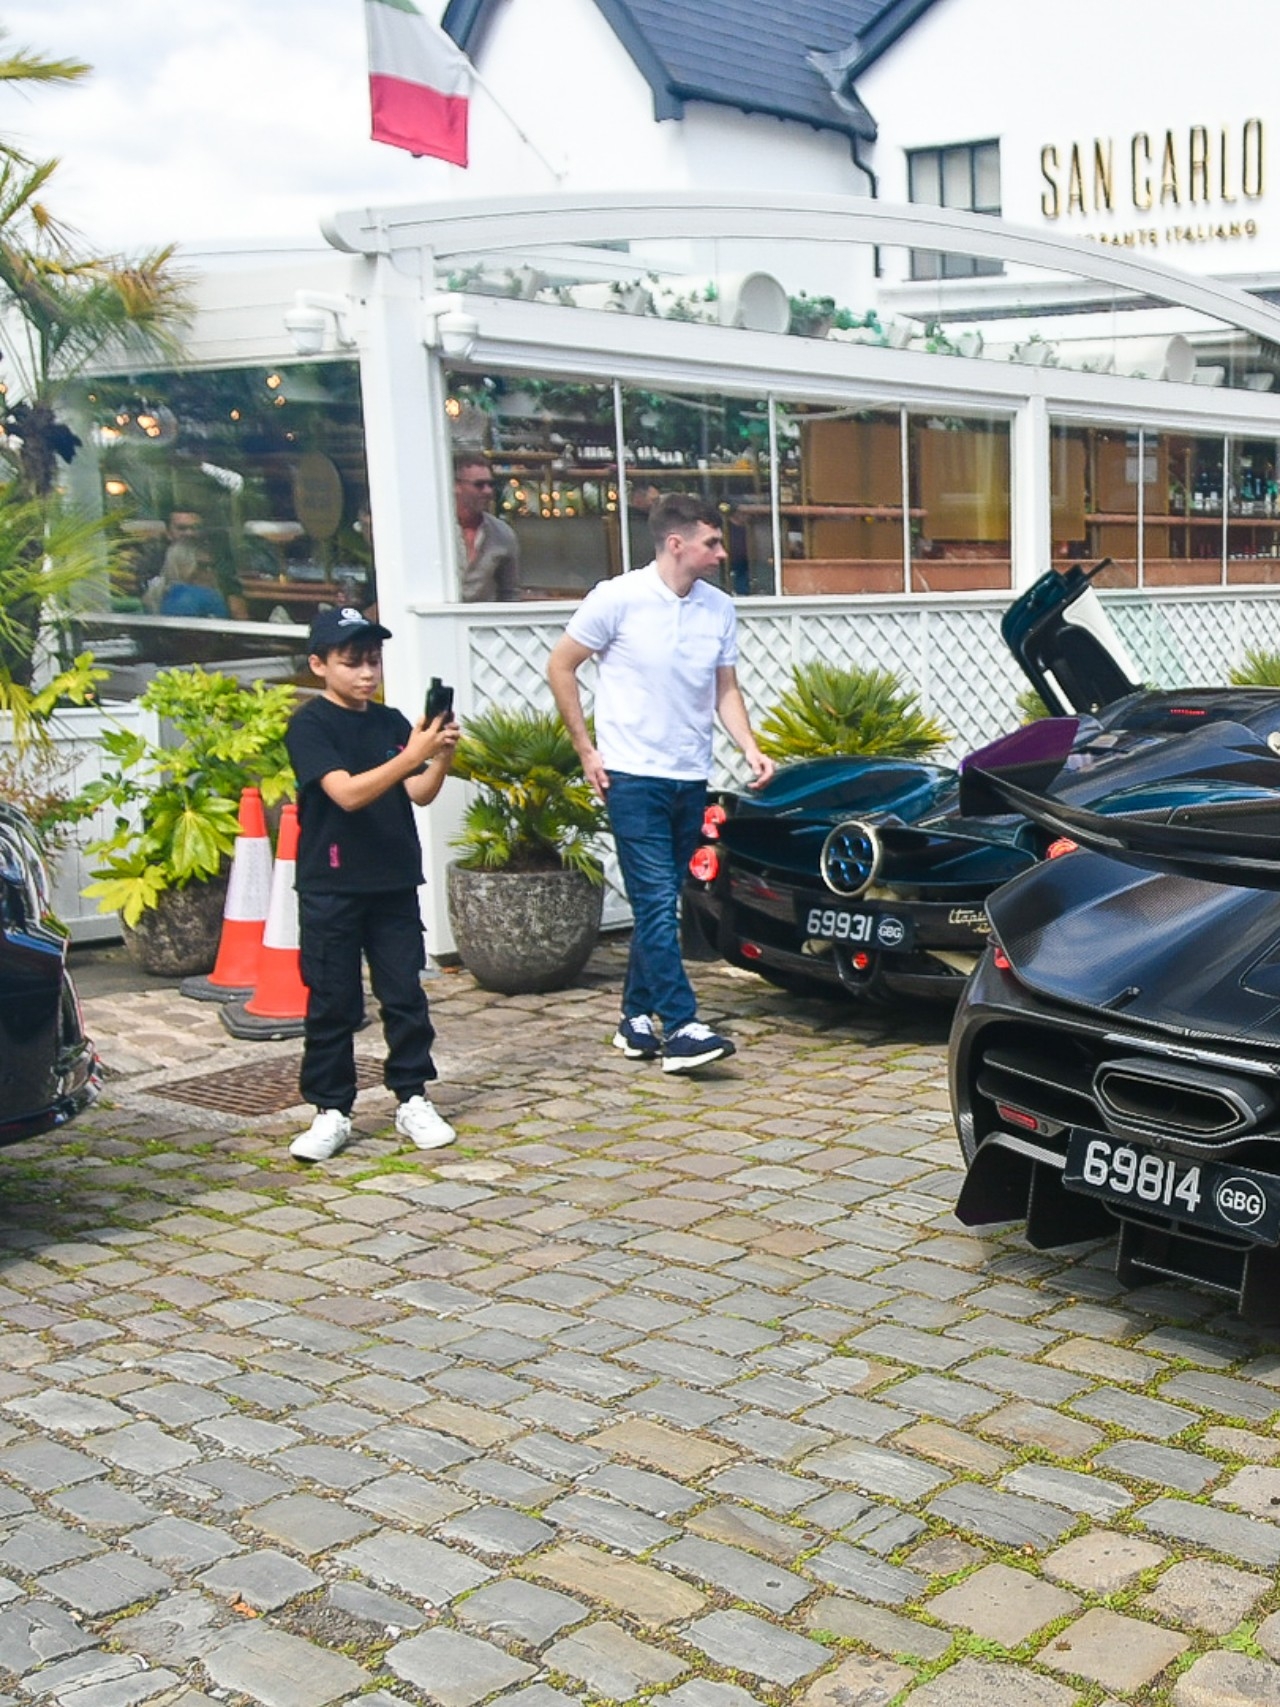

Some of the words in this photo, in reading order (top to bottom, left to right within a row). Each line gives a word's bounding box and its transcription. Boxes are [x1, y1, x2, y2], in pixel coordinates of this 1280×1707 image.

[1041, 138, 1114, 219] SAN
[1131, 117, 1264, 210] CARLO
[1165, 217, 1258, 244] ITALIANO
[807, 908, 873, 942] 69931
[878, 925, 904, 940] GBG
[1083, 1140, 1202, 1213] 69814
[1218, 1187, 1261, 1215] GBG
